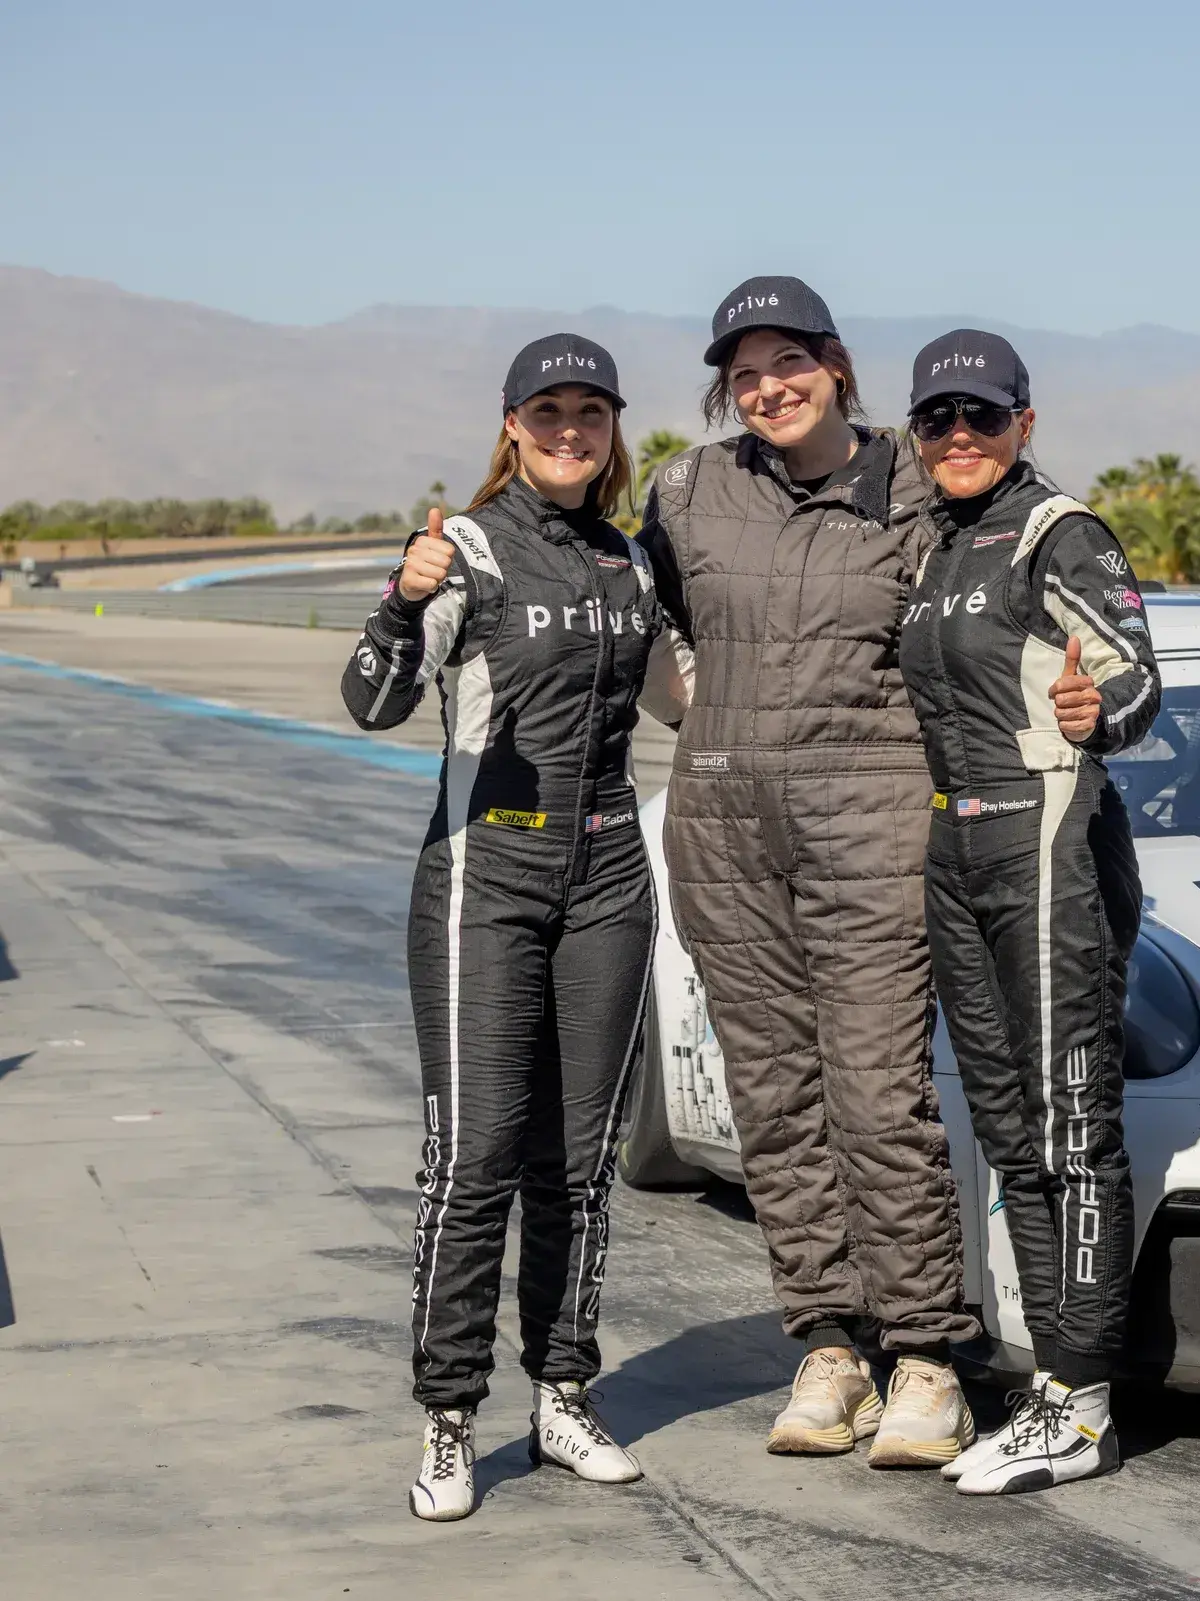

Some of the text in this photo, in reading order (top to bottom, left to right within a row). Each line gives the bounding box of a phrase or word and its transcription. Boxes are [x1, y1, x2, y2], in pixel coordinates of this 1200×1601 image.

[727, 293, 779, 323] privé
[541, 353, 597, 372] privé
[931, 353, 986, 376] privé
[1025, 506, 1057, 548] Sabelt
[451, 526, 488, 561] Sabelt
[980, 799, 1038, 814] Shay Hoelscher
[493, 810, 541, 827] Sabelt
[602, 809, 634, 828] Sabré
[545, 1428, 591, 1462] privé
